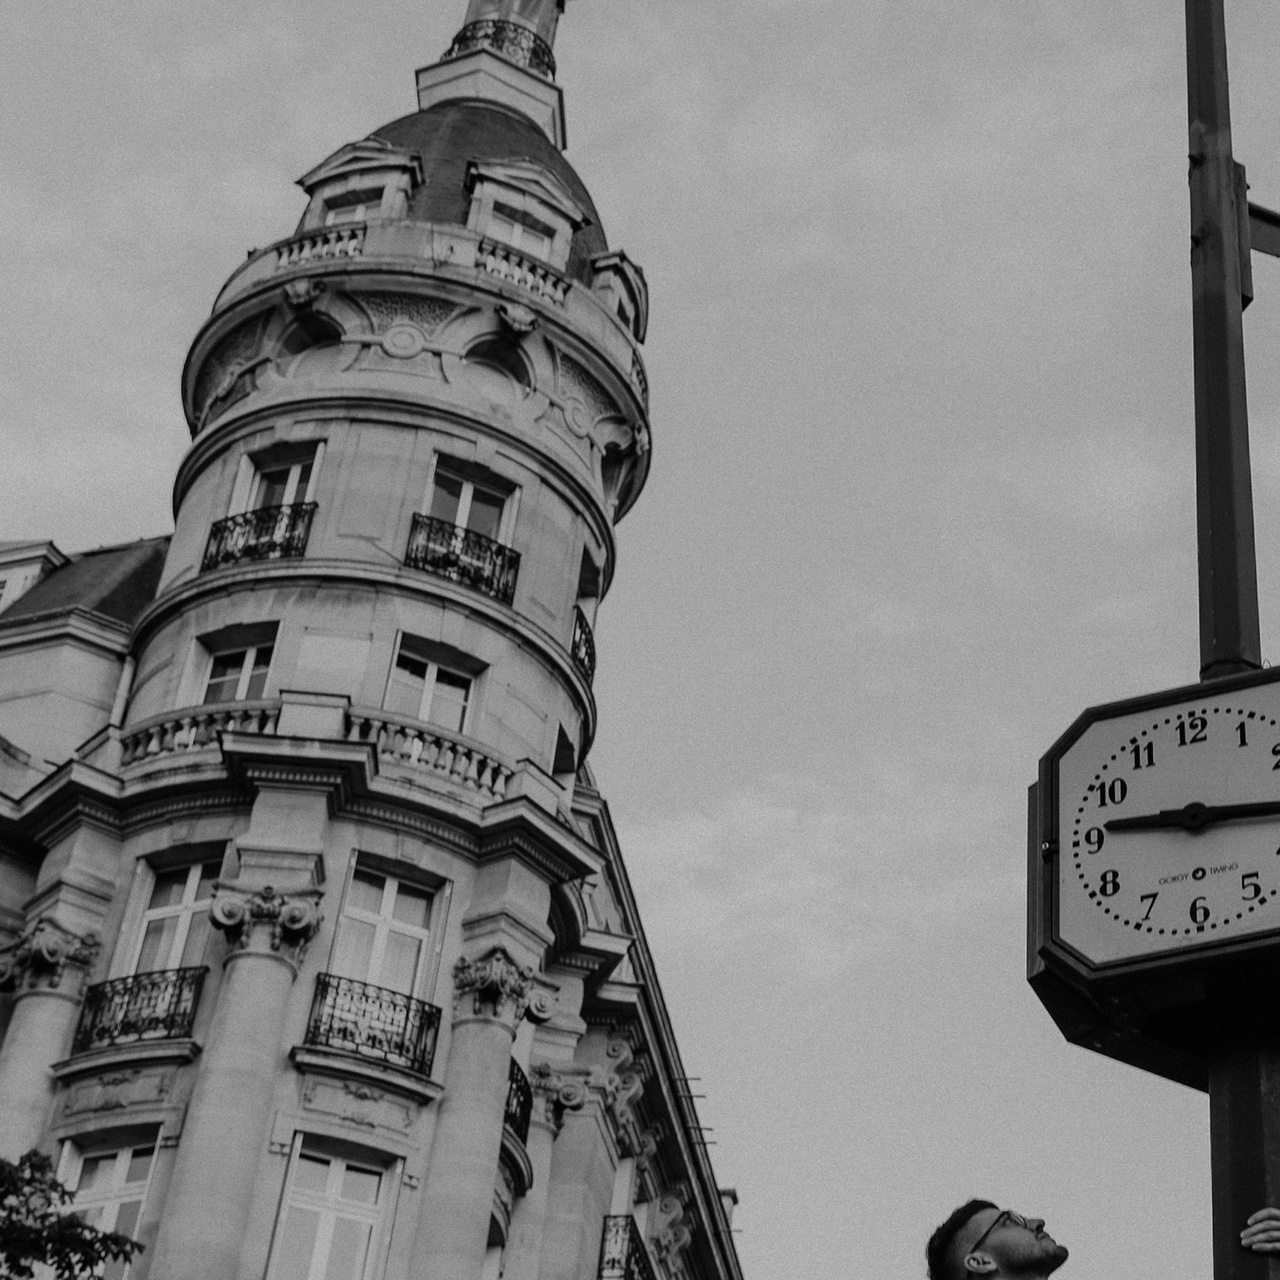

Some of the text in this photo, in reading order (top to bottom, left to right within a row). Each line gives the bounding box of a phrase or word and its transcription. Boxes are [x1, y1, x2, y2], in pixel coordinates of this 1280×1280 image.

[1175, 717, 1208, 748] 12
[1235, 721, 1249, 748] 1
[1130, 741, 1156, 771] 11
[1095, 777, 1128, 809] 10
[1084, 826, 1105, 855] 9
[1099, 869, 1121, 898] 8
[1241, 871, 1262, 901] 5
[1140, 891, 1159, 922] 7
[1189, 897, 1211, 925] 6
